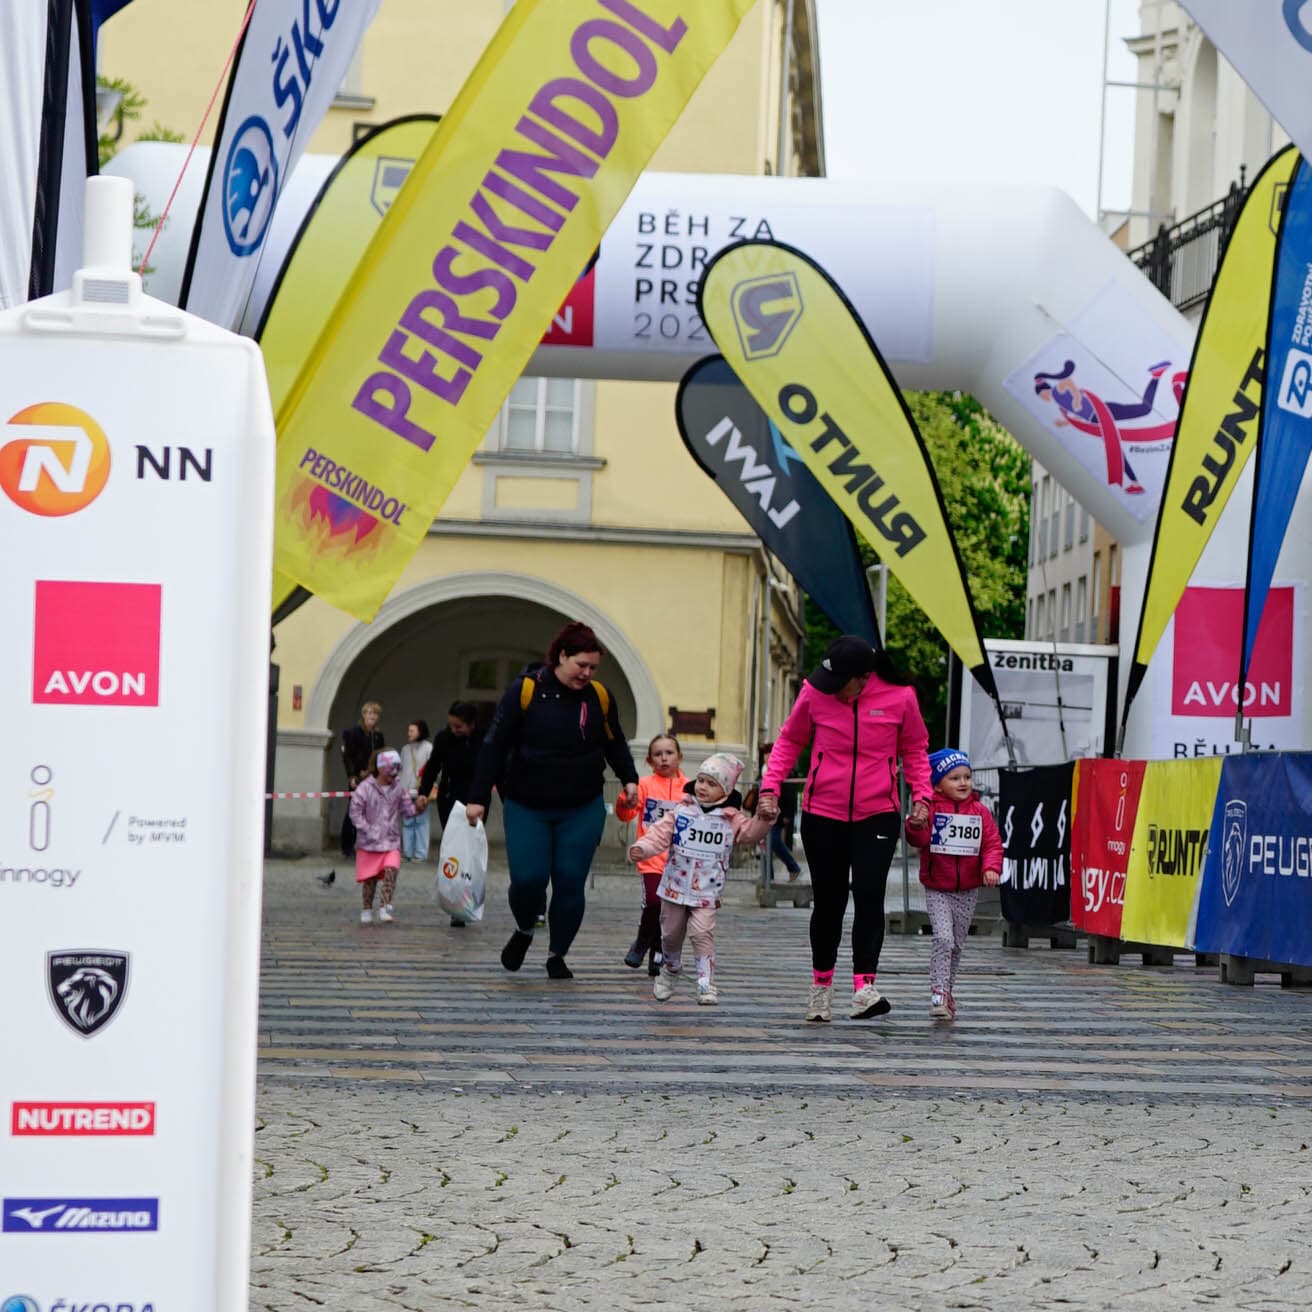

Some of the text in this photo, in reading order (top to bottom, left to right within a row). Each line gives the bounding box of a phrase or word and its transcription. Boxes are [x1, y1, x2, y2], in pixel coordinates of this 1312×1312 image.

[637, 208, 775, 240] BĚH ZA
[635, 244, 710, 271] ZDR
[634, 280, 700, 306] PRS
[633, 312, 706, 341] 202
[1180, 345, 1266, 527] RUNT
[134, 444, 214, 482] NN
[298, 447, 408, 527] PERSKINDOL
[43, 671, 146, 697] AVON
[1183, 681, 1281, 706] AVON
[128, 816, 188, 829] Powered
[948, 825, 980, 840] 3180
[128, 831, 145, 845] by
[688, 828, 723, 845] 3100
[18, 1106, 151, 1131] NUTREND
